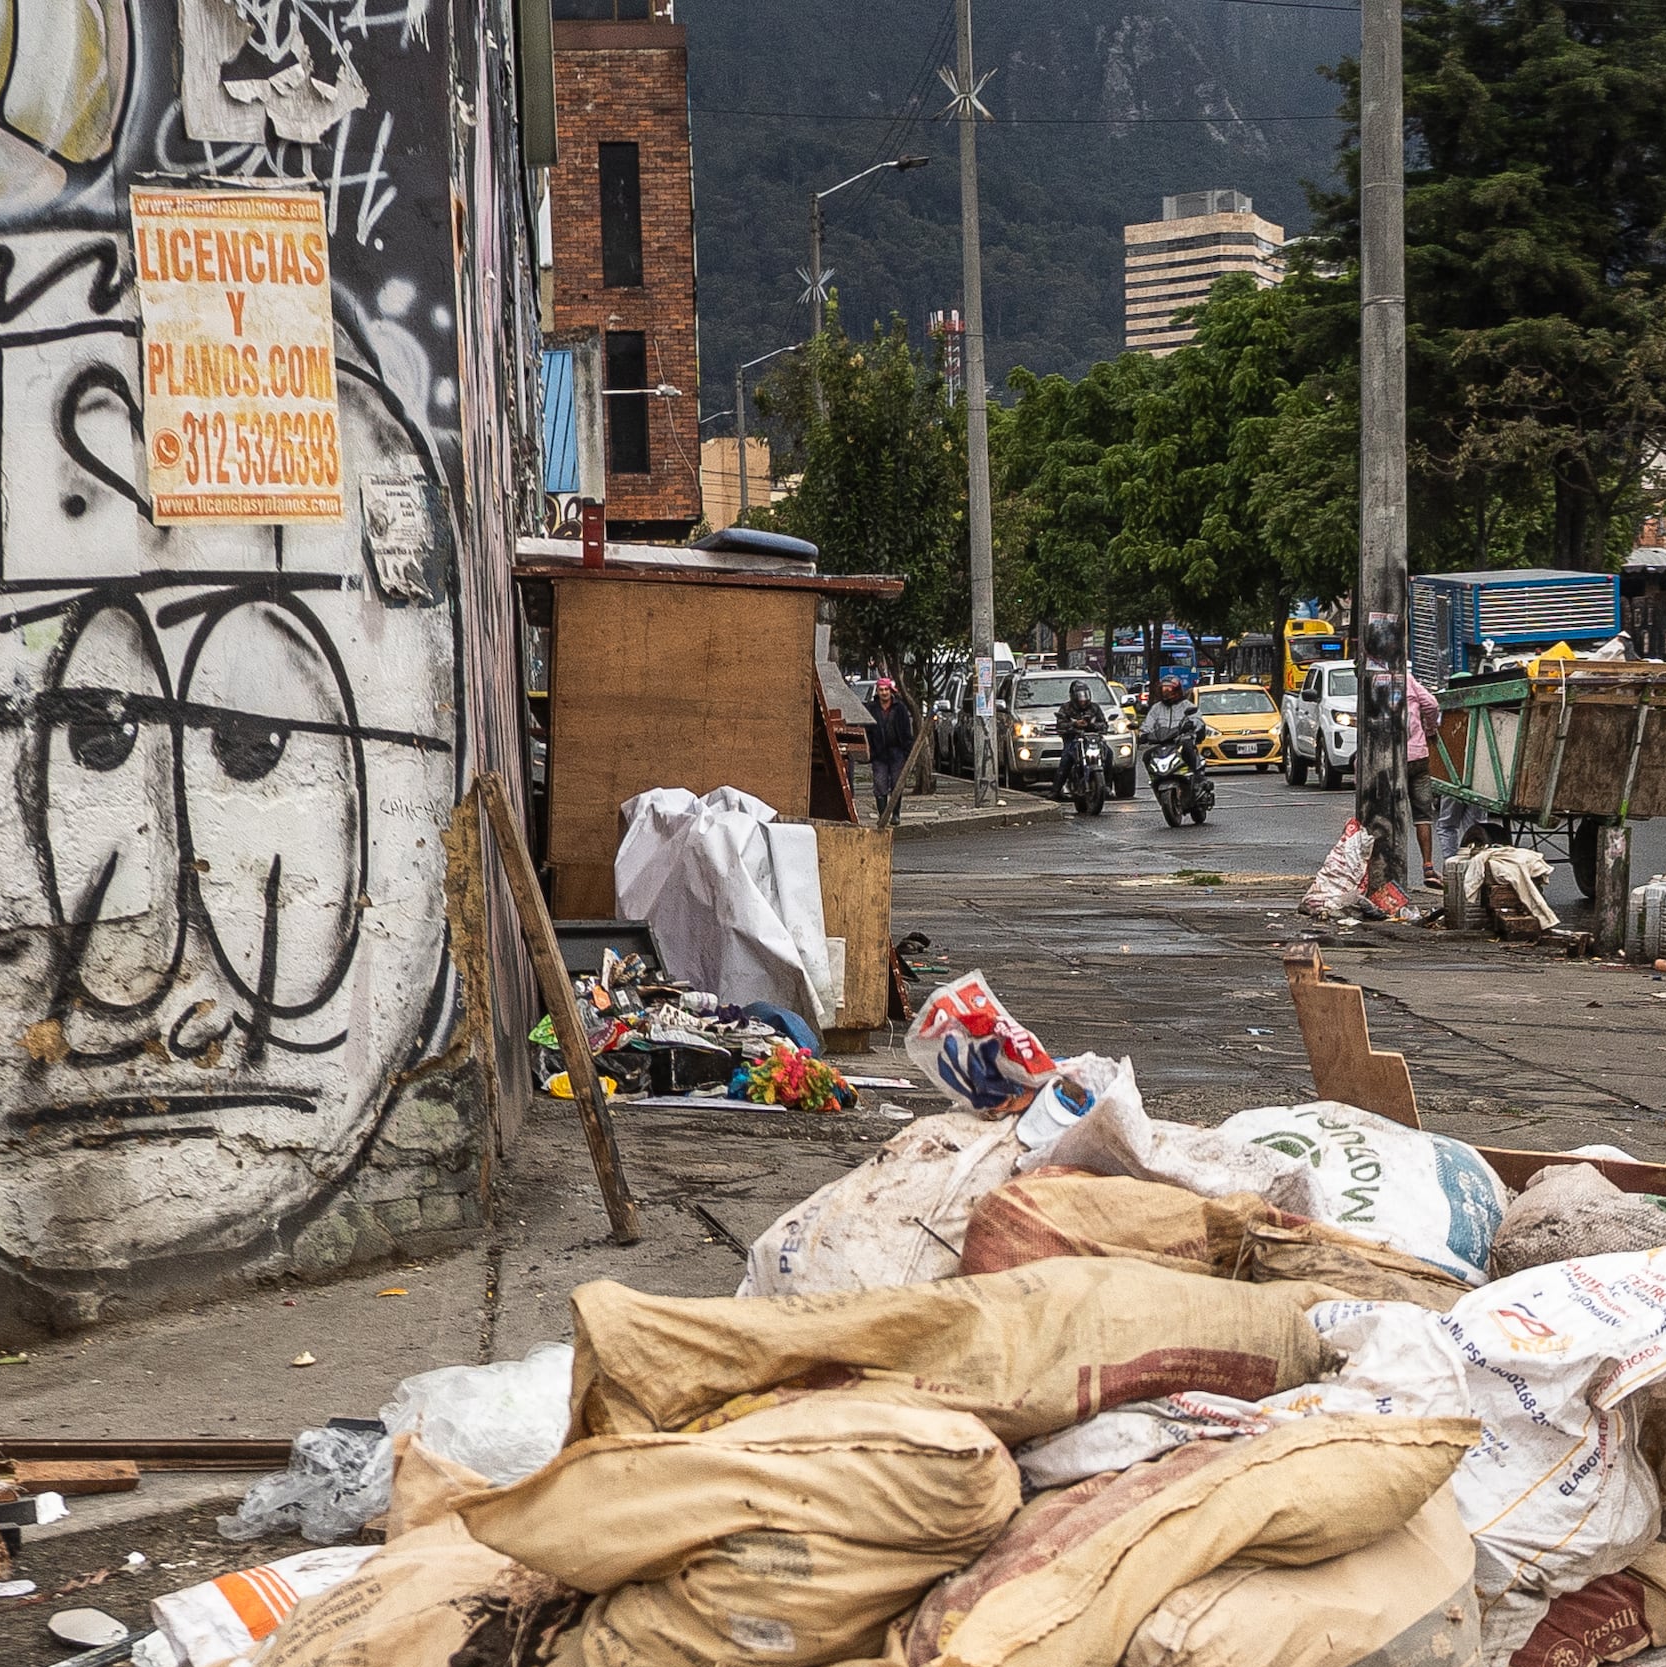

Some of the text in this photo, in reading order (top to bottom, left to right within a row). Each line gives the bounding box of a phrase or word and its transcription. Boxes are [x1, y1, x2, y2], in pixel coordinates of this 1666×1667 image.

[137, 227, 325, 286] LICENCIAS
[226, 291, 245, 337] Y
[147, 343, 332, 400] PLANOS.COM
[183, 411, 230, 486] 312
[160, 496, 340, 515] www.licenciasyplanos.com
